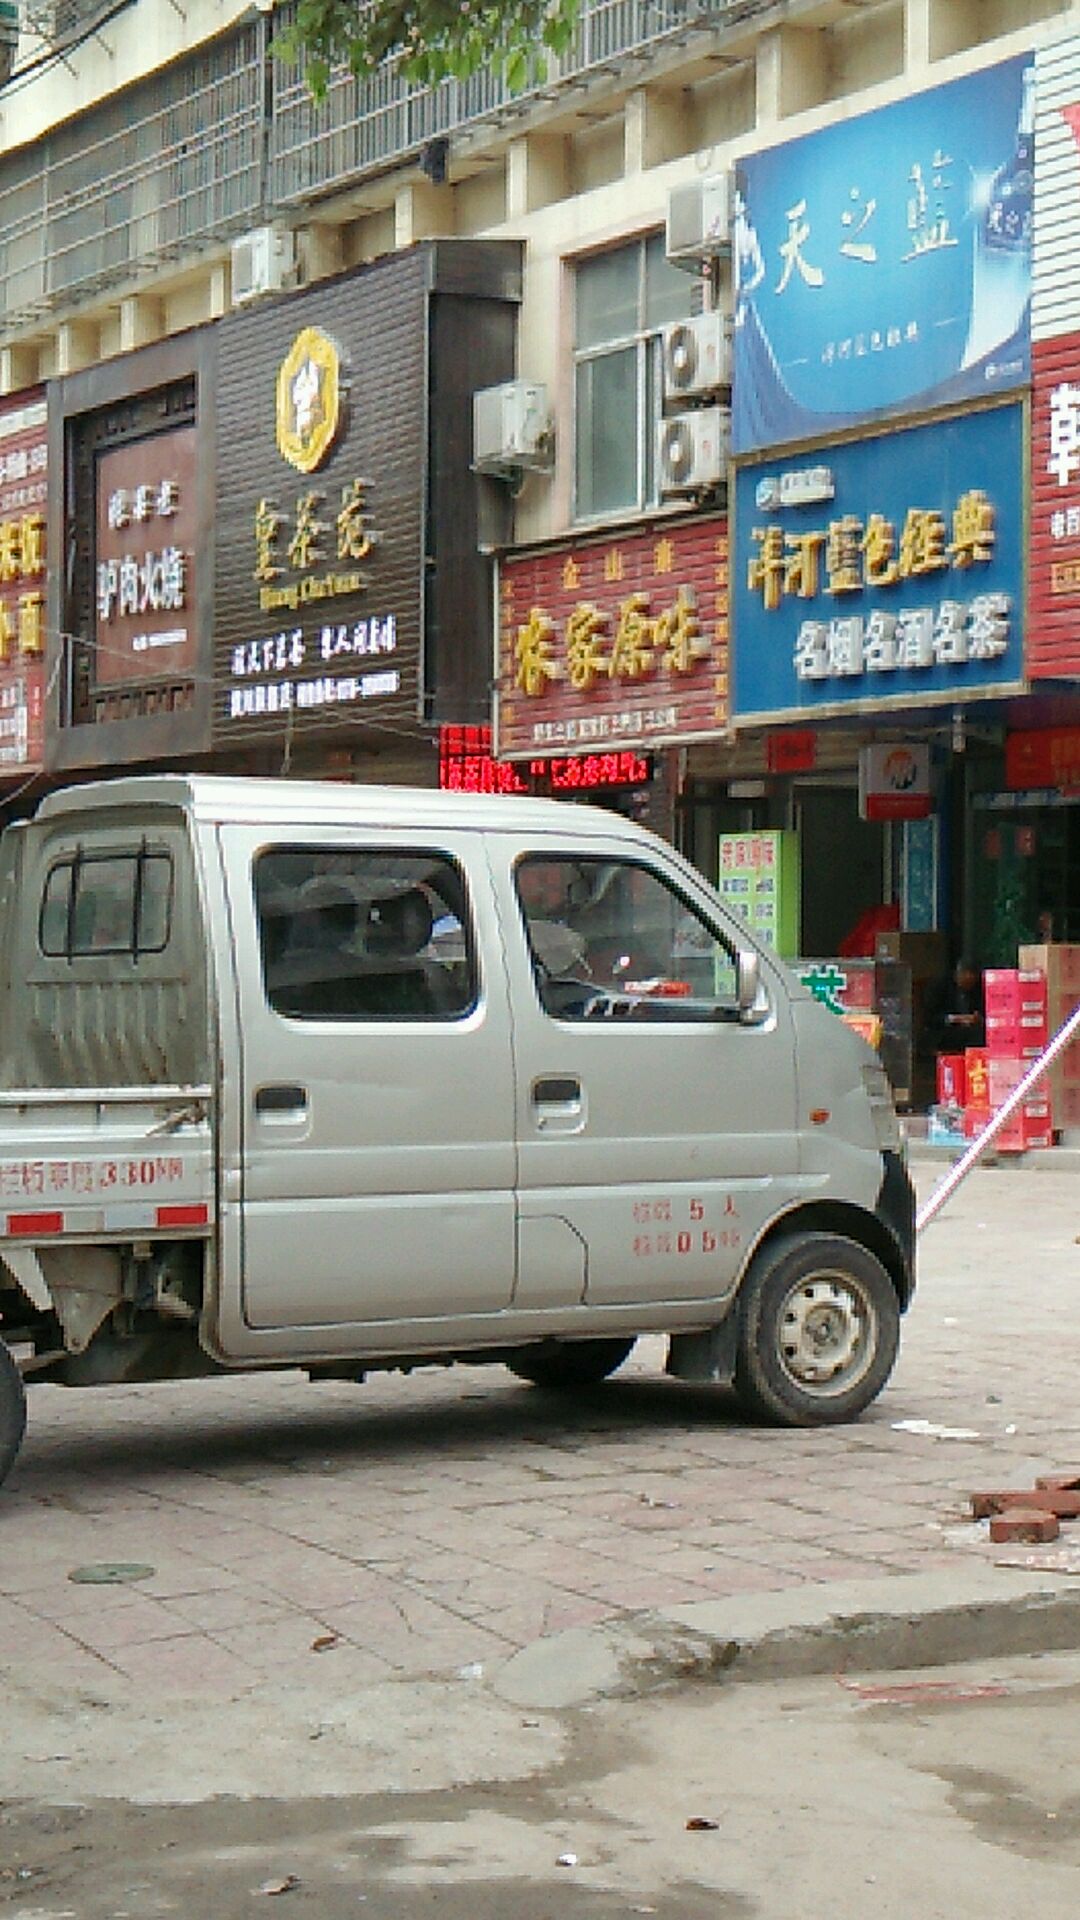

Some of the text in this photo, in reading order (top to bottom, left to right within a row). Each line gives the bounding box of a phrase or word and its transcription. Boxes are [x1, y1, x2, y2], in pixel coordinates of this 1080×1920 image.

[793, 593, 1011, 679] 名烟名酒名茶
